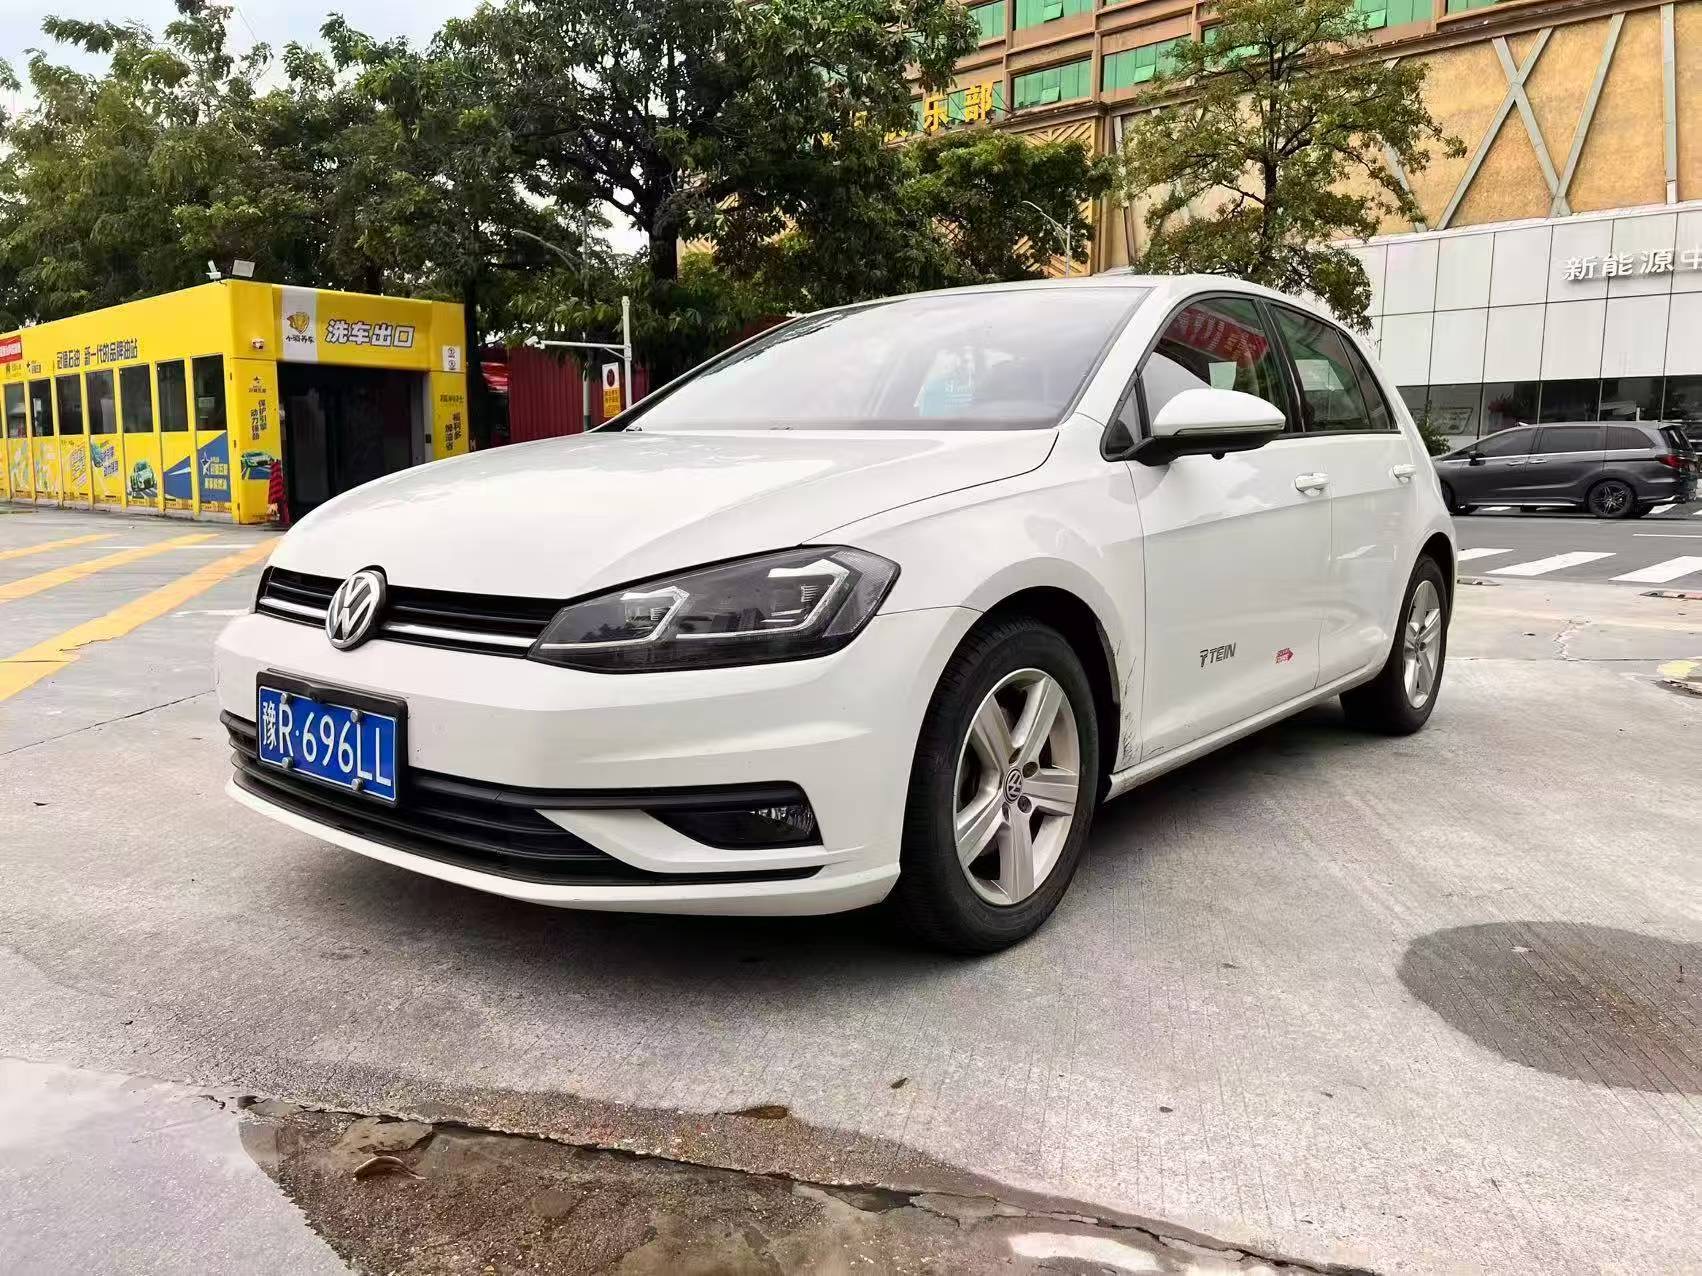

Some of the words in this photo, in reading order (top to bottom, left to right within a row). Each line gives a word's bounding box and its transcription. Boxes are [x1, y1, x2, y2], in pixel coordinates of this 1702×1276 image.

[1562, 244, 1702, 281] 新能源中
[325, 319, 415, 348] 洗车出口
[262, 700, 392, 787] 豫R·696LL
